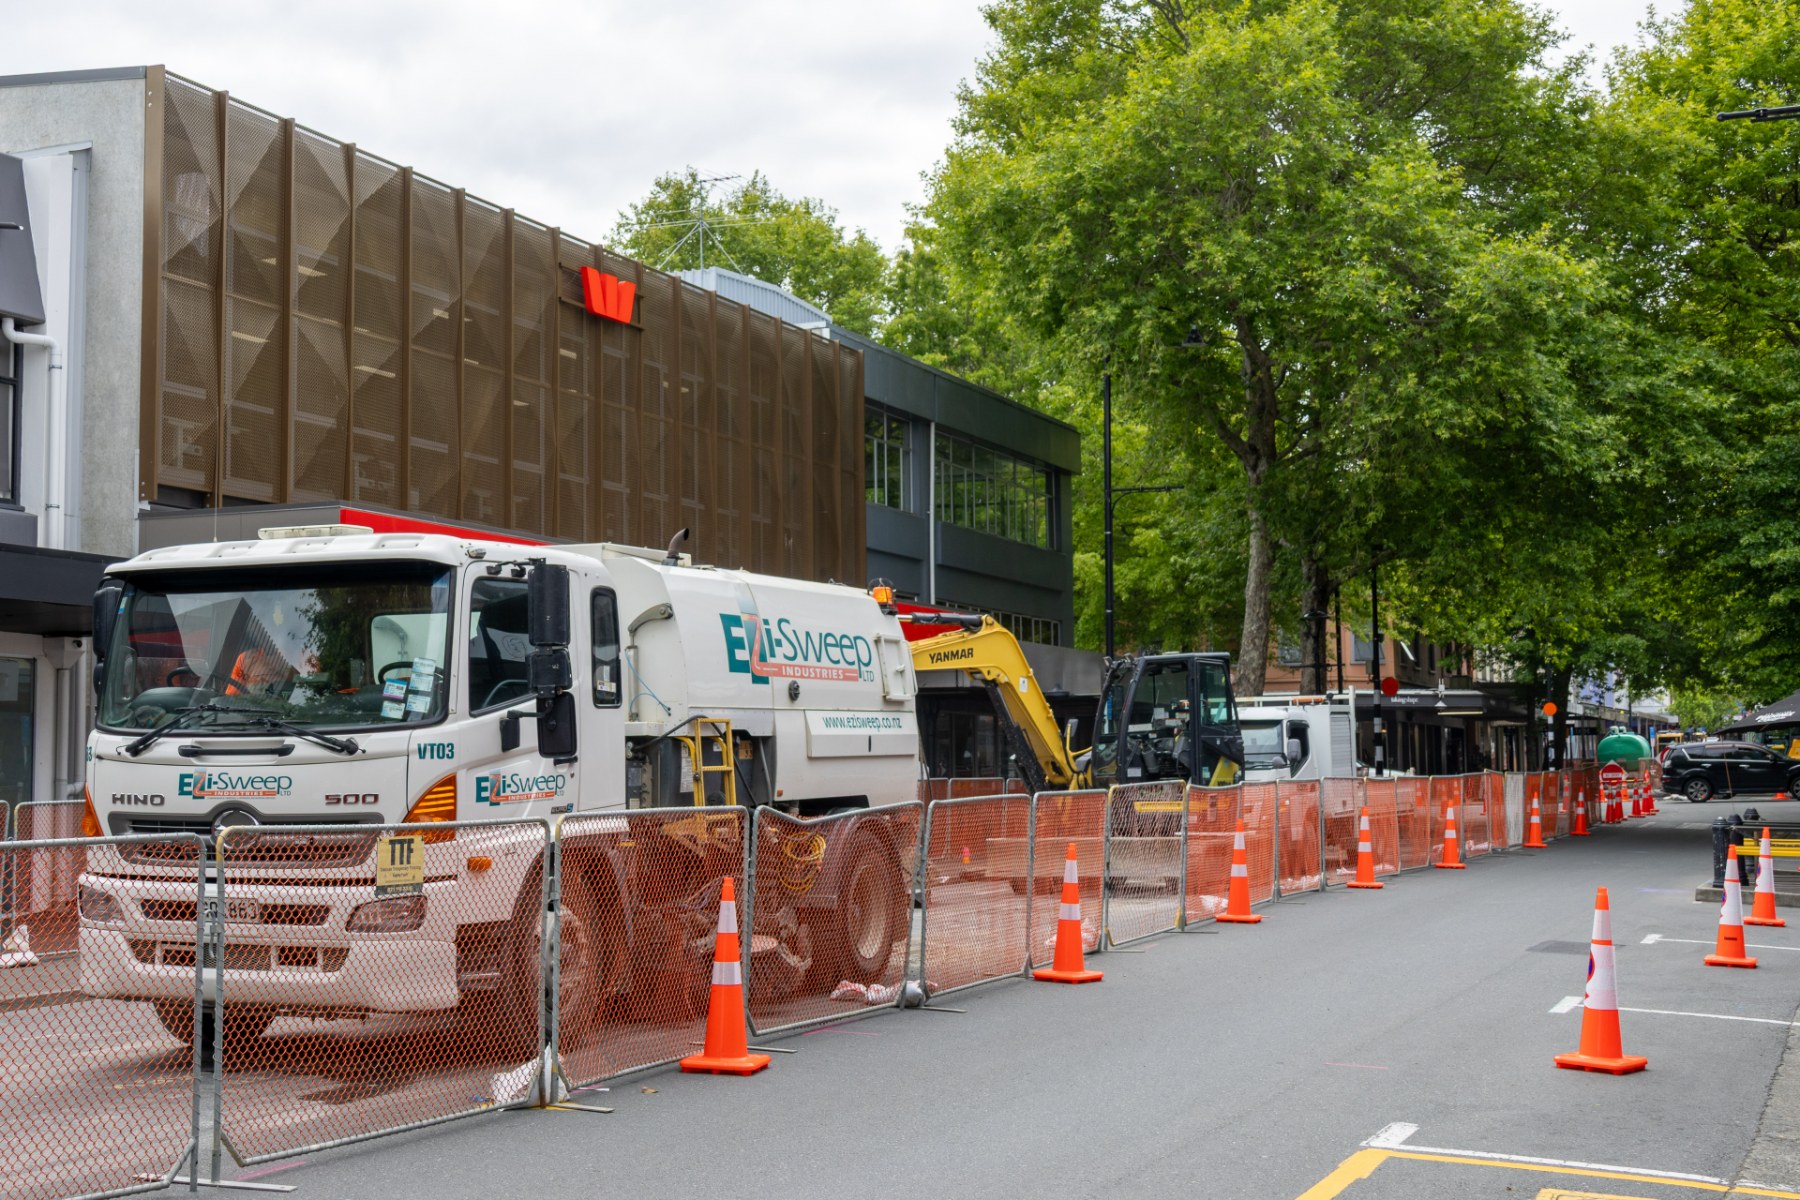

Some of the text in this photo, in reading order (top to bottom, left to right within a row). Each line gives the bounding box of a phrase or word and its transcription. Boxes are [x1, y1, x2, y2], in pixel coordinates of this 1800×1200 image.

[929, 647, 974, 664] YANMAR
[782, 665, 875, 683] INDUSTRIES LTD
[822, 714, 903, 733] www.ezisweep.co.nz
[417, 742, 456, 760] VT03
[111, 793, 166, 807] HINO
[324, 793, 380, 806] 500
[508, 792, 547, 801] INDUSTRIES
[388, 837, 415, 866] TTF
